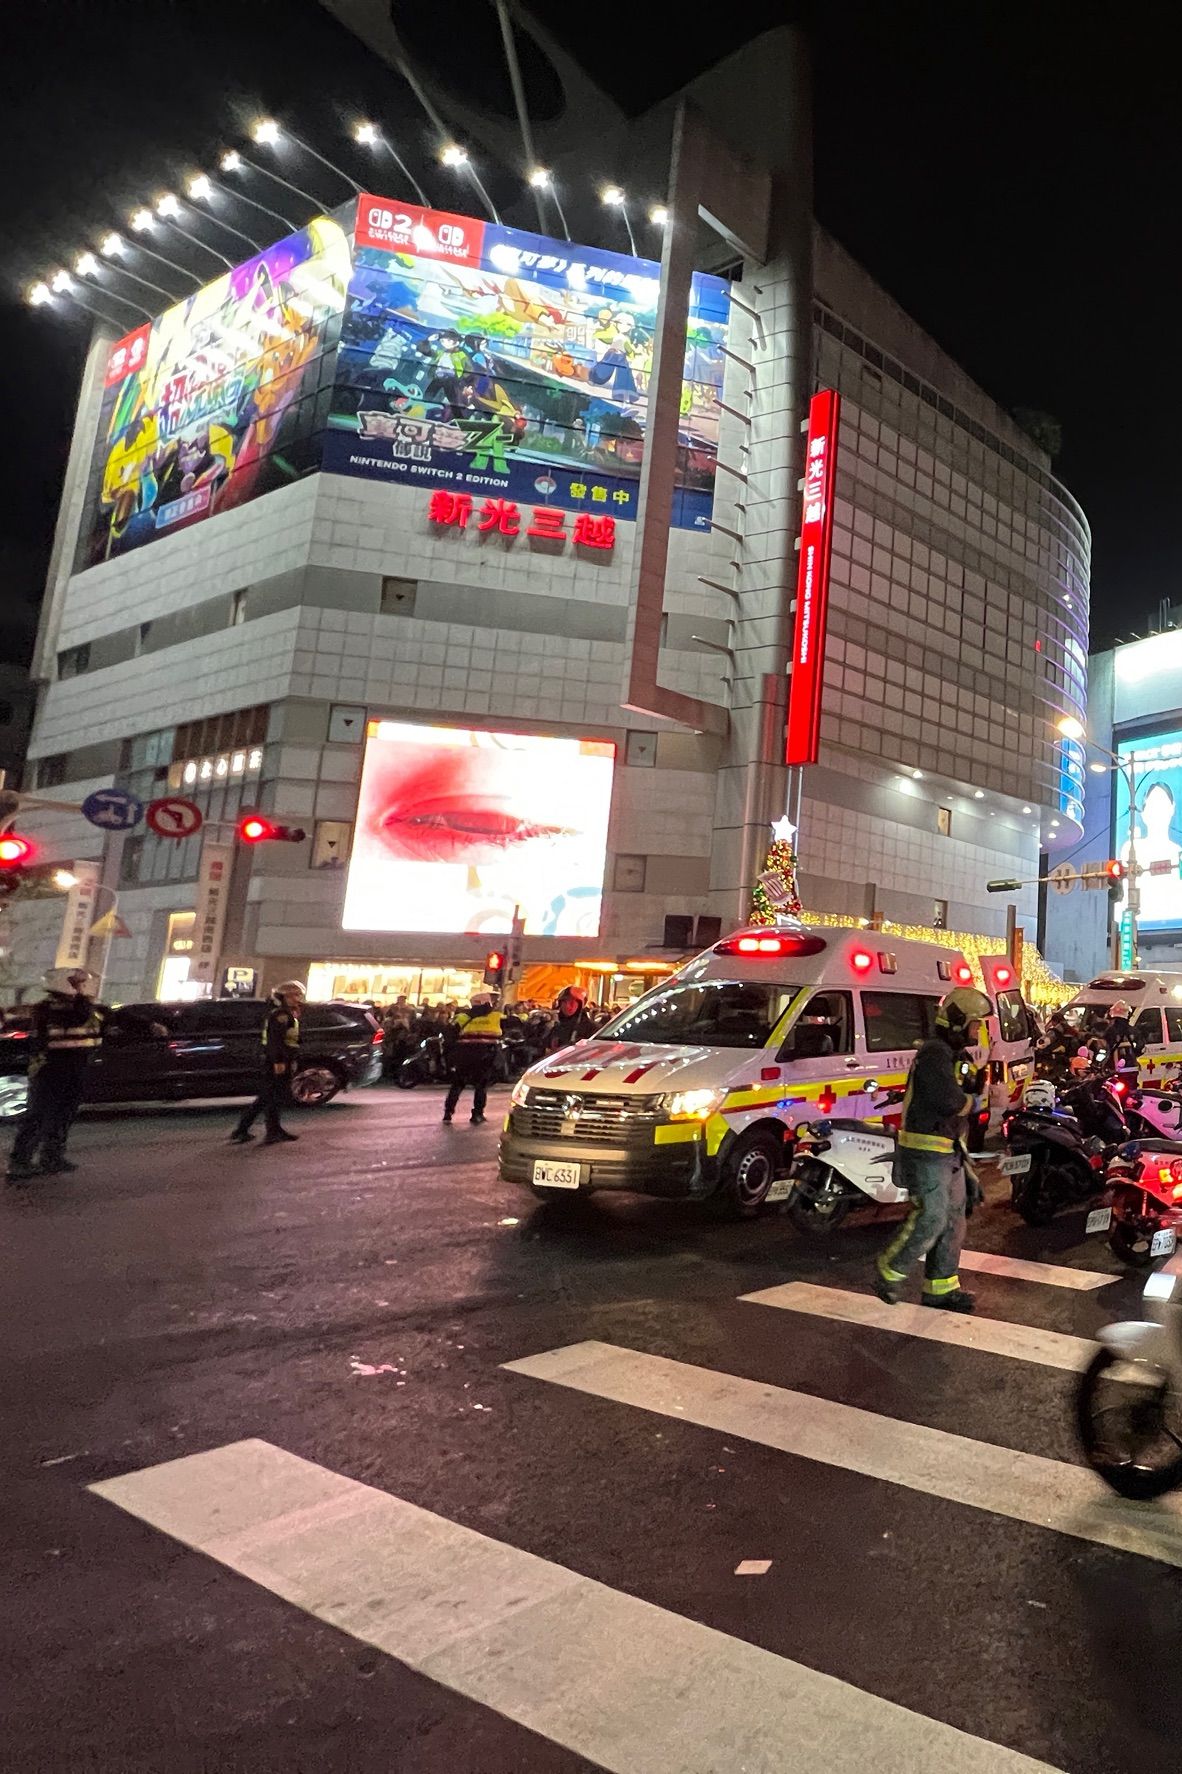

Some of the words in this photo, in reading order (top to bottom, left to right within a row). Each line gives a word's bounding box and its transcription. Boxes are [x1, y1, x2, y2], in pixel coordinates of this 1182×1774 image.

[350, 455, 407, 471] NINTENDO
[410, 465, 453, 479] SWITCH
[456, 472, 463, 480] 2
[466, 474, 509, 488] EDITION
[428, 489, 616, 549] 新光三越
